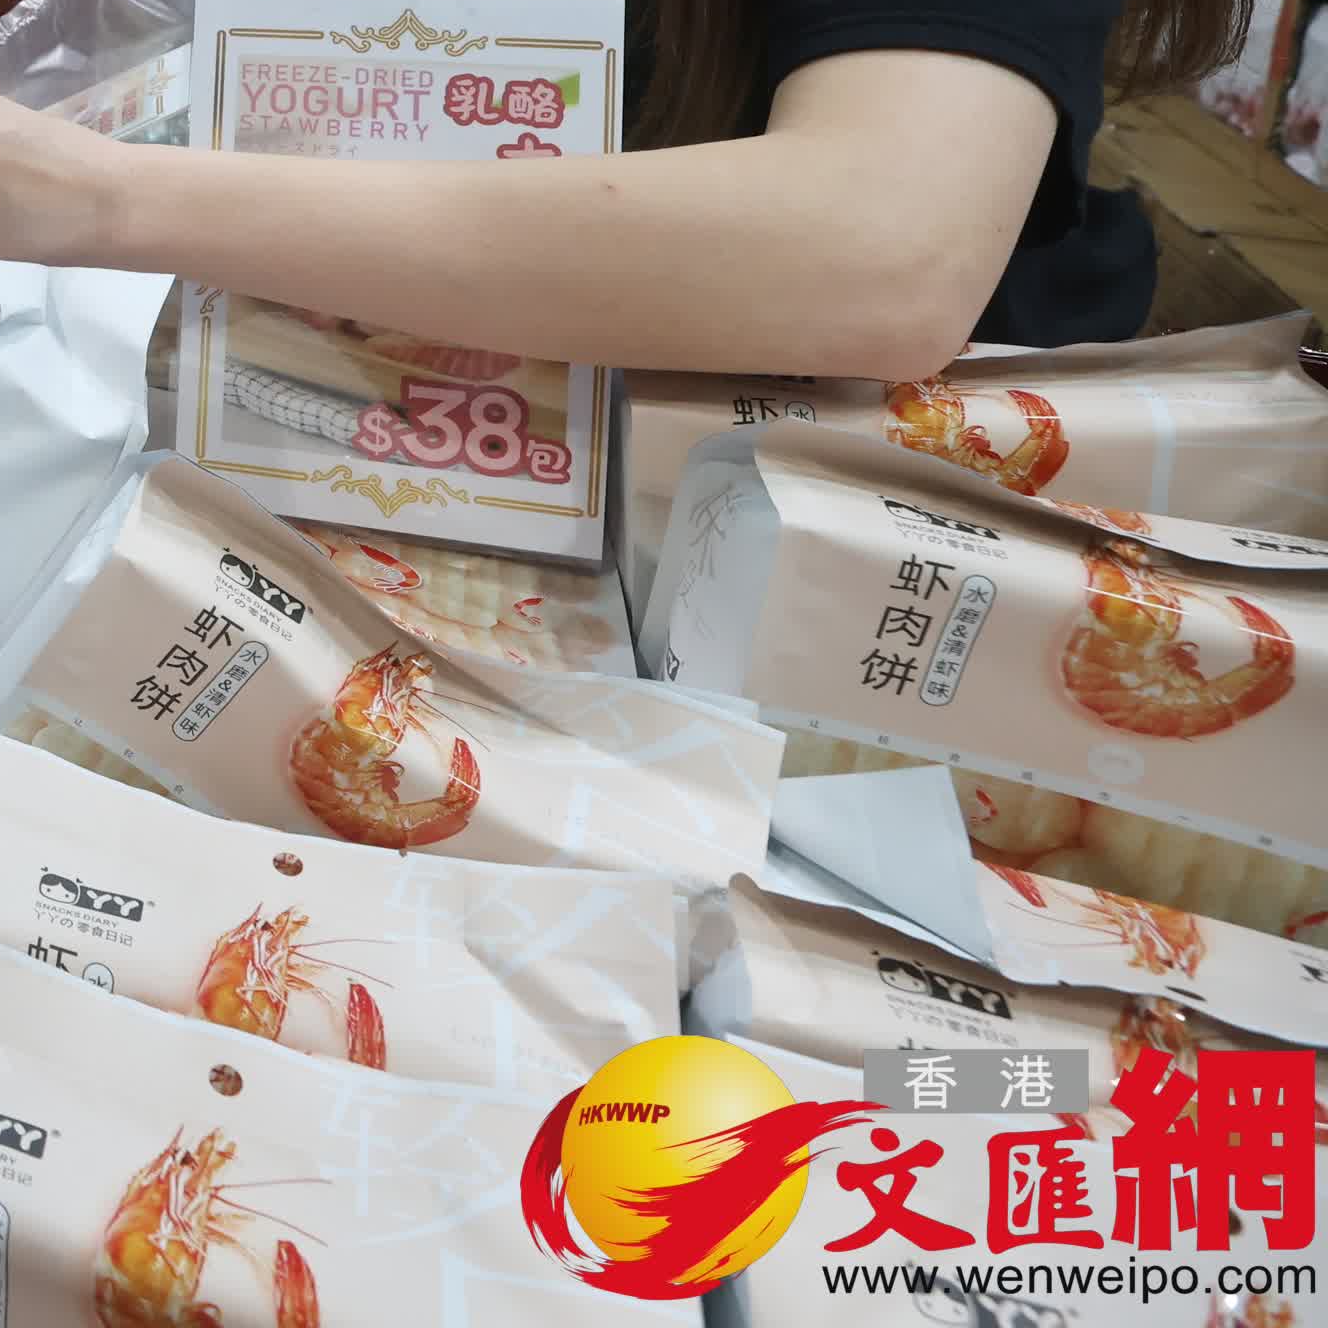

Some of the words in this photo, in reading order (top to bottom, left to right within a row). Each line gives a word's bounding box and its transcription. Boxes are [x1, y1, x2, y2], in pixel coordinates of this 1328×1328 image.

[240, 63, 434, 88] FREEZE-DRIED
[241, 82, 432, 123] YOGURT
[447, 76, 562, 126] 乳酪
[239, 114, 431, 142] STAWBERRY
[352, 376, 572, 484] $38包
[732, 395, 779, 426] 虾
[860, 553, 957, 696] 虾肉饼
[130, 605, 245, 721] 虾肉饼
[179, 648, 263, 736] 水磨&清虾味
[35, 900, 81, 919] SNACKS
[83, 913, 118, 929] DIARY
